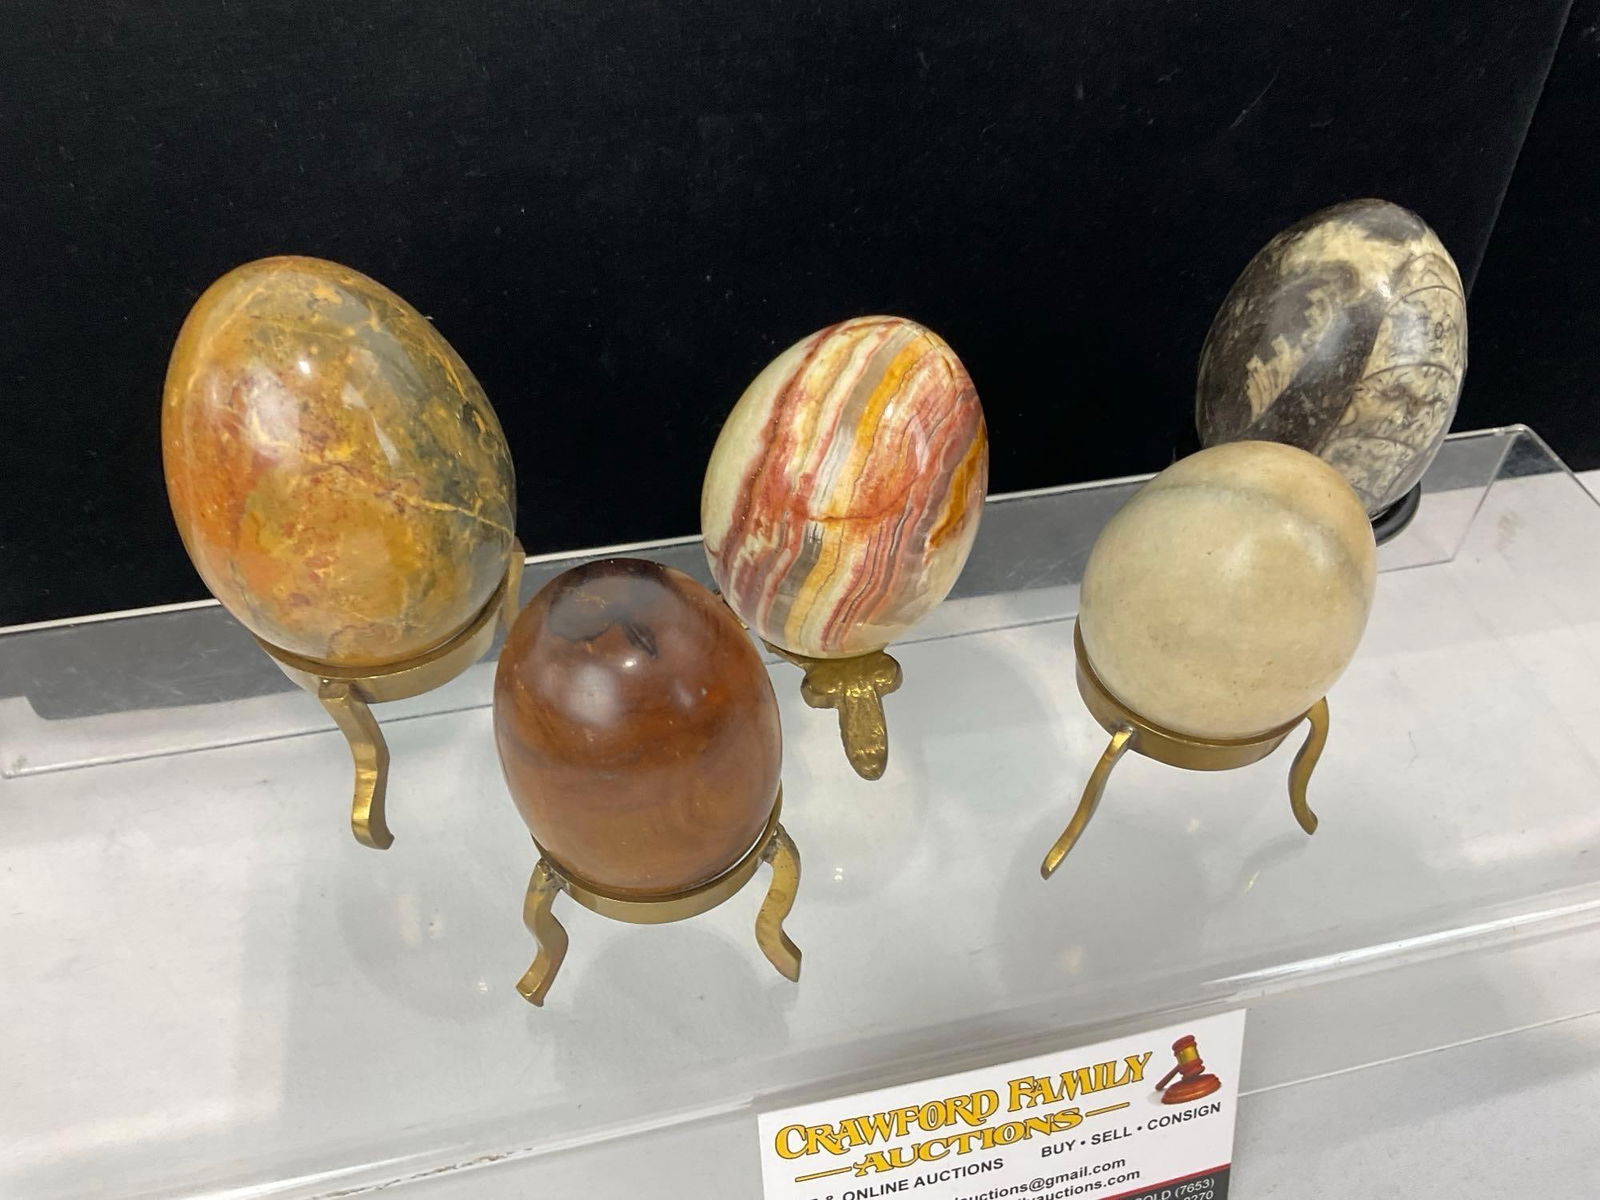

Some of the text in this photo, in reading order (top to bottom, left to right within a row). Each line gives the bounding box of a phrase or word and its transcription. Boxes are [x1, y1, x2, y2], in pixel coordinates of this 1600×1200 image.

[775, 1051, 1153, 1159] CRAWFORD FAMILY
[1041, 1101, 1221, 1158] BUY SELL CONSIGN
[853, 1107, 1084, 1177] AUCTIONS
[842, 1158, 1004, 1200] ONLINE AUCTIONS
[1175, 1178, 1215, 1197] (7653)
